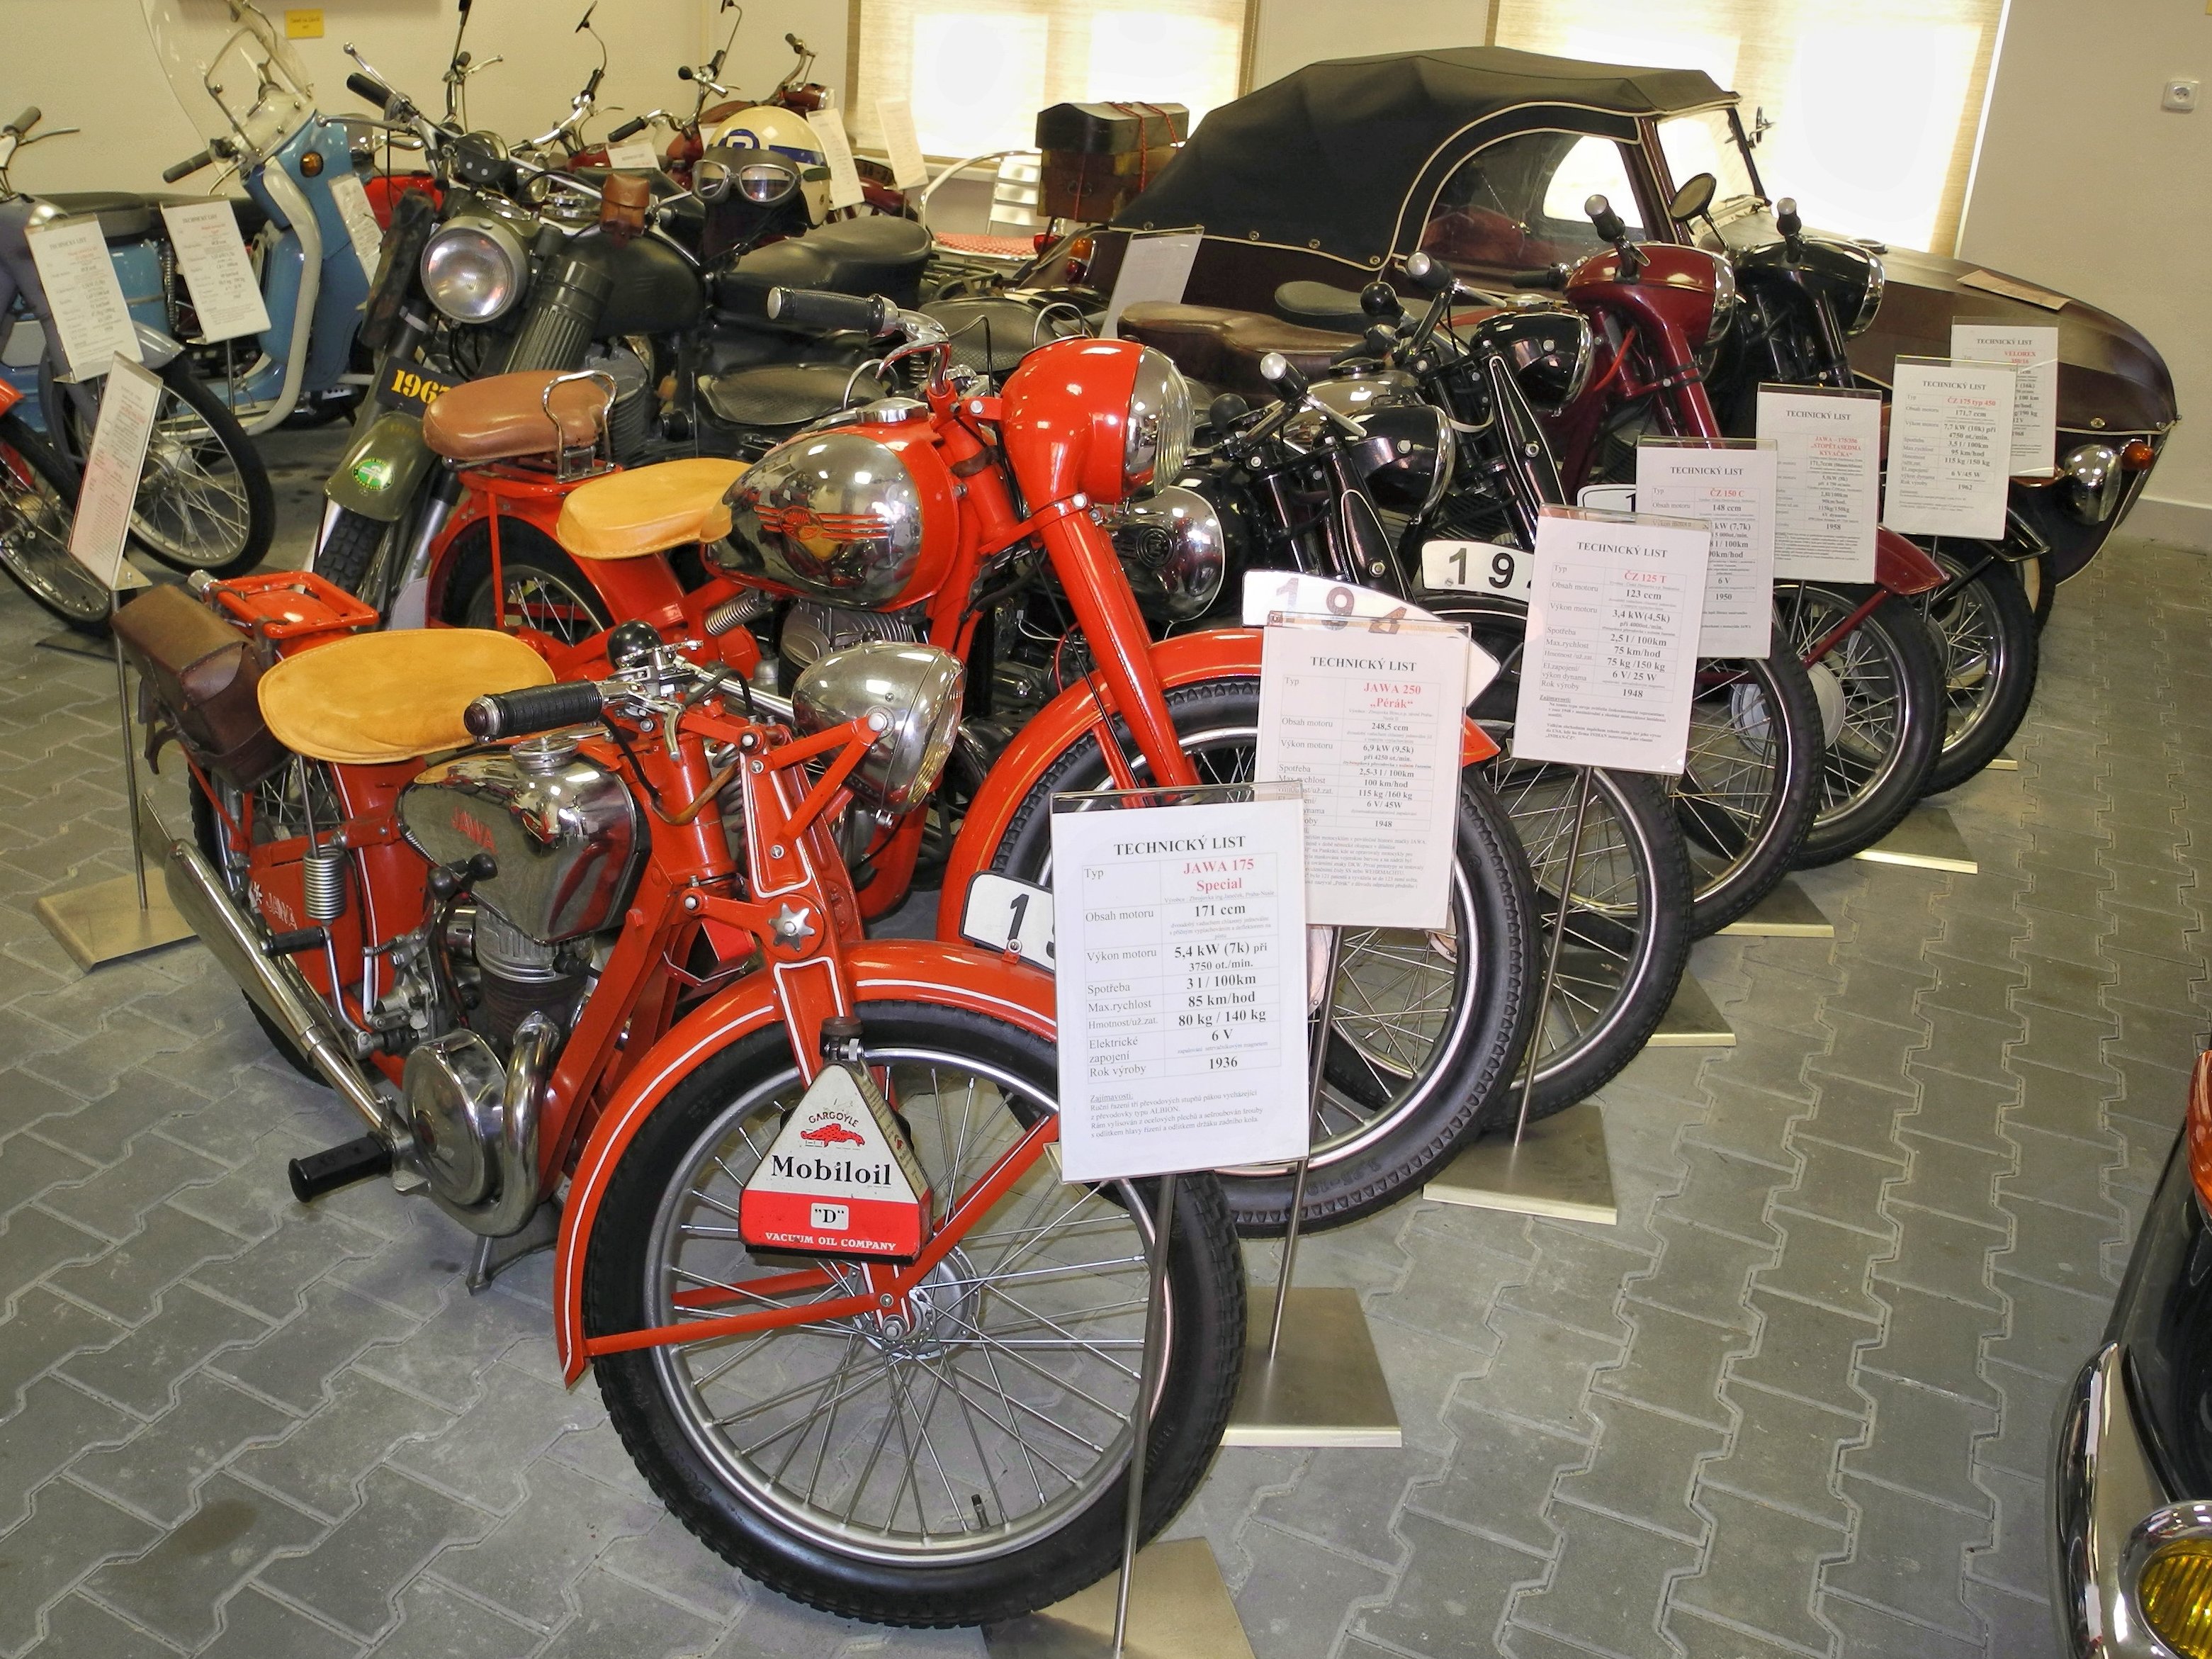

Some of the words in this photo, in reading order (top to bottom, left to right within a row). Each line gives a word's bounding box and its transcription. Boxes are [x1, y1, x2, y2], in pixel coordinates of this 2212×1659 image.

[1923, 381, 1967, 389] TECHNICKÝ
[1786, 410, 1832, 419] TECHNICKÝ
[1670, 466, 1722, 476] TECHNICKÝ
[1710, 488, 1722, 497] ČZ
[1576, 541, 1640, 555] TECHNICKÝ
[1643, 548, 1668, 558] LIST
[1449, 548, 1531, 589] 19
[1624, 570, 1639, 580] ČZ
[1642, 573, 1657, 583] 125
[1660, 575, 1667, 583] T
[1552, 581, 1572, 590] Obsah
[1550, 602, 1571, 612] Výkon
[1612, 609, 1625, 619] 3,4
[1628, 611, 1671, 624] kW(4,5k)
[1547, 626, 1576, 636] Spotřeba
[1610, 634, 1624, 643] 2,5
[1637, 636, 1667, 646] 100km
[1614, 646, 1625, 654] 75
[1627, 646, 1661, 658] km/hod
[1310, 656, 1385, 670] TECHNICKÝ
[1389, 660, 1417, 672] LIST
[1607, 658, 1617, 666] 75
[1620, 658, 1630, 669] kg
[1632, 660, 1652, 669] /150
[1654, 661, 1665, 673] kg
[1285, 677, 1299, 685] Typ
[1633, 672, 1644, 680] 25
[1647, 673, 1657, 682] W
[1363, 682, 1399, 694] JAWA
[1403, 685, 1421, 694] 250
[1623, 688, 1643, 698] 1948
[1281, 717, 1305, 726] Obsah
[1307, 719, 1333, 728] motoru
[1371, 722, 1392, 731] 248,5
[1280, 739, 1304, 749] Výkon
[1307, 741, 1333, 750] motoru
[1362, 744, 1375, 753] 6,9
[1392, 746, 1414, 755] (9,5k)
[1278, 764, 1311, 773] Spotřeba
[1359, 767, 1378, 777] 2,5-3
[1389, 770, 1414, 778] 100km
[1379, 780, 1409, 788] km/hod
[1358, 789, 1372, 797] 115
[1373, 789, 1383, 799] kg
[1384, 789, 1401, 798] /160
[1402, 792, 1413, 801] kg
[1113, 835, 1207, 855] TECHNICKÝ
[1212, 836, 1246, 850] LIST
[1183, 862, 1227, 875] JAWA
[1232, 858, 1254, 872] 175
[1084, 867, 1104, 880] Typ
[1196, 877, 1242, 893] Special
[1085, 911, 1116, 923] Obsah
[1119, 909, 1154, 920] motoru
[1195, 904, 1215, 917] 171
[1220, 905, 1246, 915] ccm
[1087, 952, 1119, 964] Výkon
[1122, 949, 1157, 960] motoru
[1174, 945, 1193, 960] 5,4
[1197, 943, 1220, 957] kW
[1224, 941, 1250, 956] (7k)
[1253, 942, 1268, 954] při
[1188, 961, 1212, 972] 3750
[1215, 959, 1253, 970] ot./min.
[1186, 977, 1194, 990] 3
[1214, 974, 1256, 986] 100km
[1087, 982, 1131, 996] Spotřeba
[1088, 999, 1152, 1013] Max.rychlost
[1187, 995, 1203, 1008] 85
[1207, 991, 1256, 1006] km/hod
[1088, 1016, 1158, 1030] Hmotnost/už.zat.
[1178, 1013, 1193, 1026] 80
[1197, 1012, 1212, 1028] kg
[1224, 1009, 1246, 1023] 140
[1251, 1008, 1266, 1023] kg
[1089, 1035, 1139, 1050] Elektrické
[1089, 1050, 1130, 1064] zapojení
[1209, 1056, 1238, 1069] 1936
[1089, 1067, 1110, 1078] Rok
[1112, 1064, 1146, 1078] výroby
[808, 1110, 859, 1127] GARGOYLE
[772, 1154, 891, 1186] Mobiloil
[818, 1237, 837, 1247] OIL
[840, 1238, 896, 1252] COMPANY
